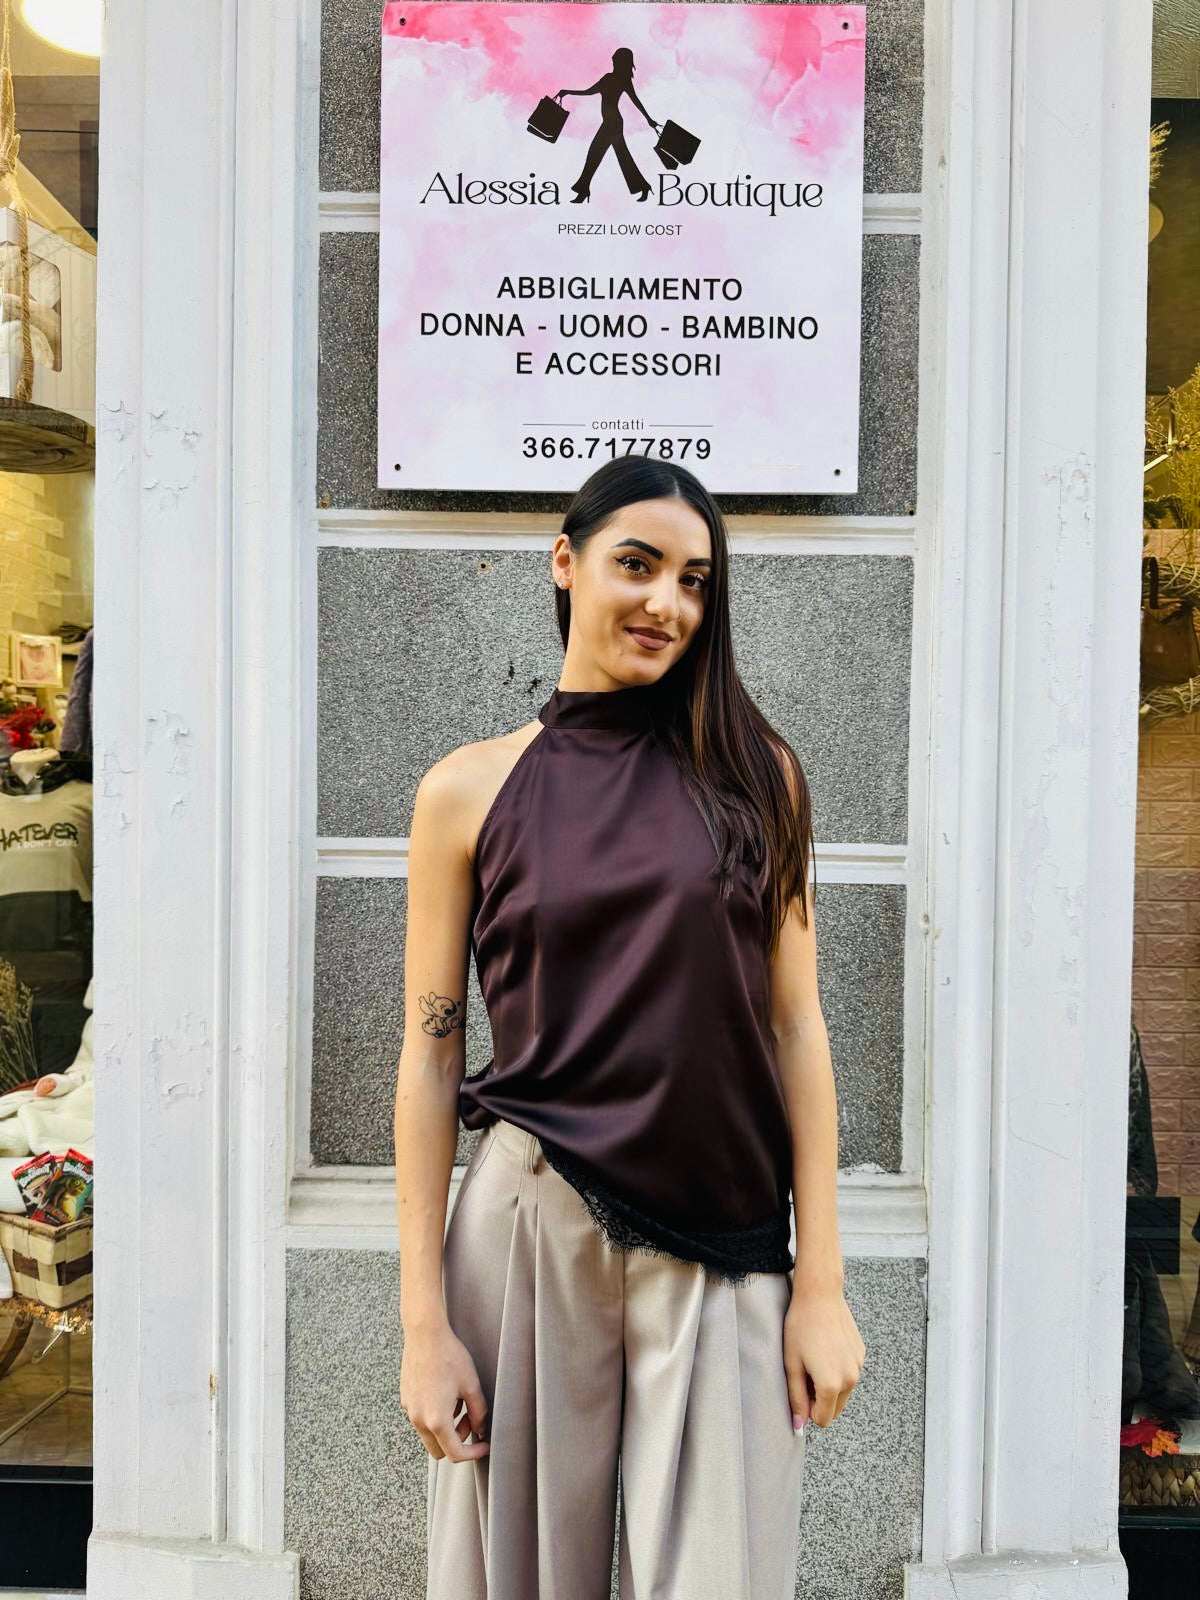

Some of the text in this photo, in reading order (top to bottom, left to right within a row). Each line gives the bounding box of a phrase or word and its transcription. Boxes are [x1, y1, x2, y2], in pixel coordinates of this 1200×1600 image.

[420, 172, 823, 217] Alessia Boutique
[557, 223, 682, 236] PREZZI LOW COST
[497, 277, 743, 301] ABBIGLIAMENTO
[420, 312, 526, 337] DONNA
[559, 313, 648, 339] UOMO
[682, 315, 819, 340] BAMBINO
[516, 352, 721, 377] E ACCESSORI
[591, 419, 645, 430] contatti
[522, 437, 711, 460] 366.7177879
